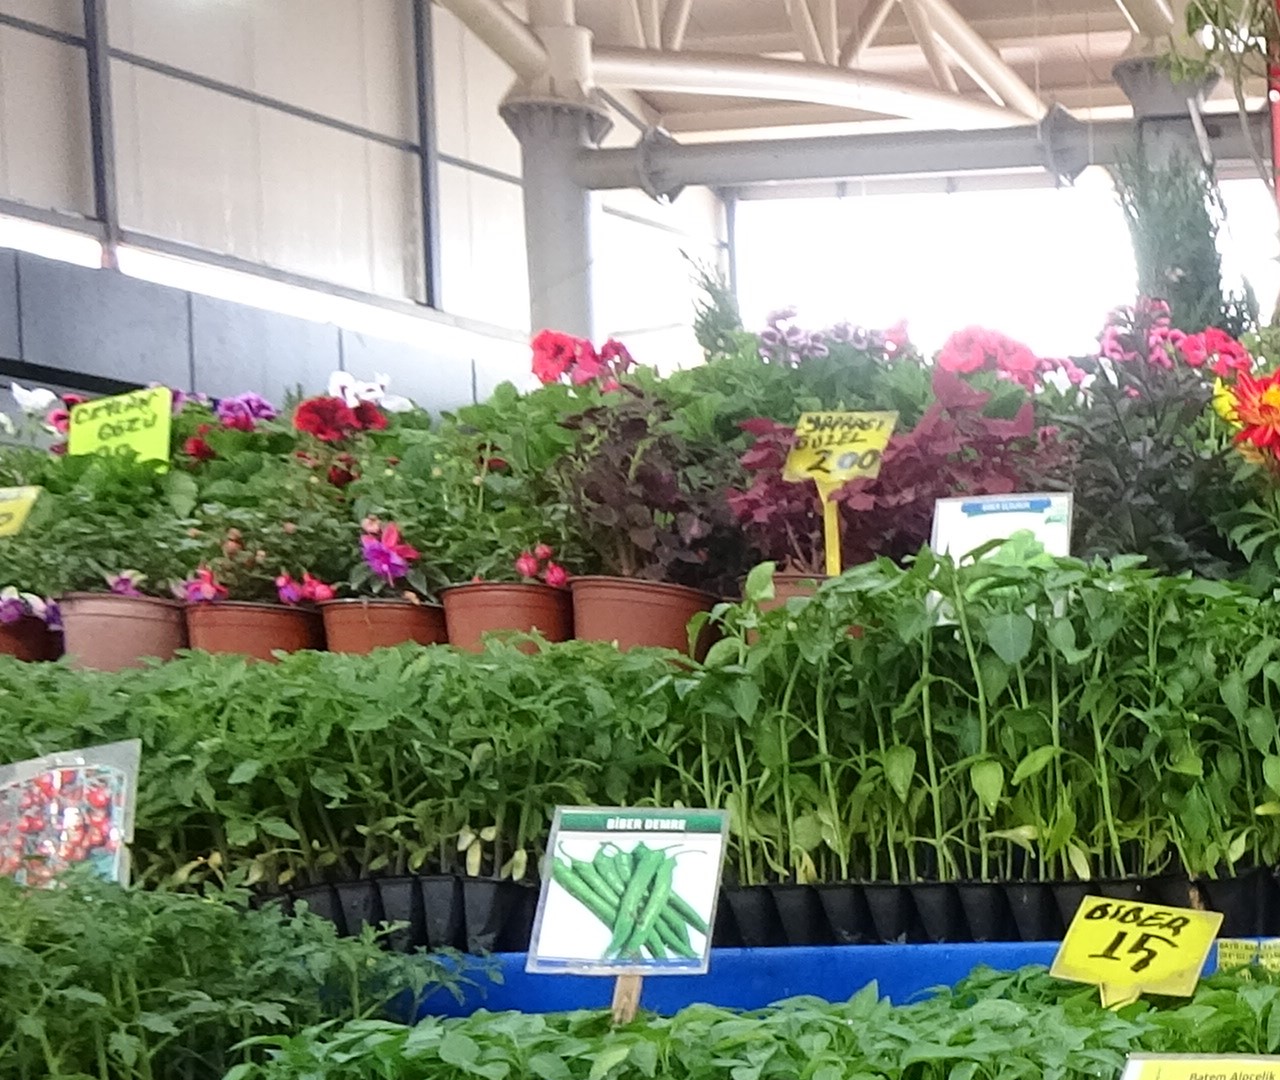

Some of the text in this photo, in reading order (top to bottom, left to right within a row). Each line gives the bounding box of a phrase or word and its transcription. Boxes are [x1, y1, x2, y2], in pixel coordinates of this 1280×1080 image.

[806, 449, 881, 474] 200
[606, 817, 687, 831] BİBER DEMRE
[1088, 931, 1179, 973] 15
